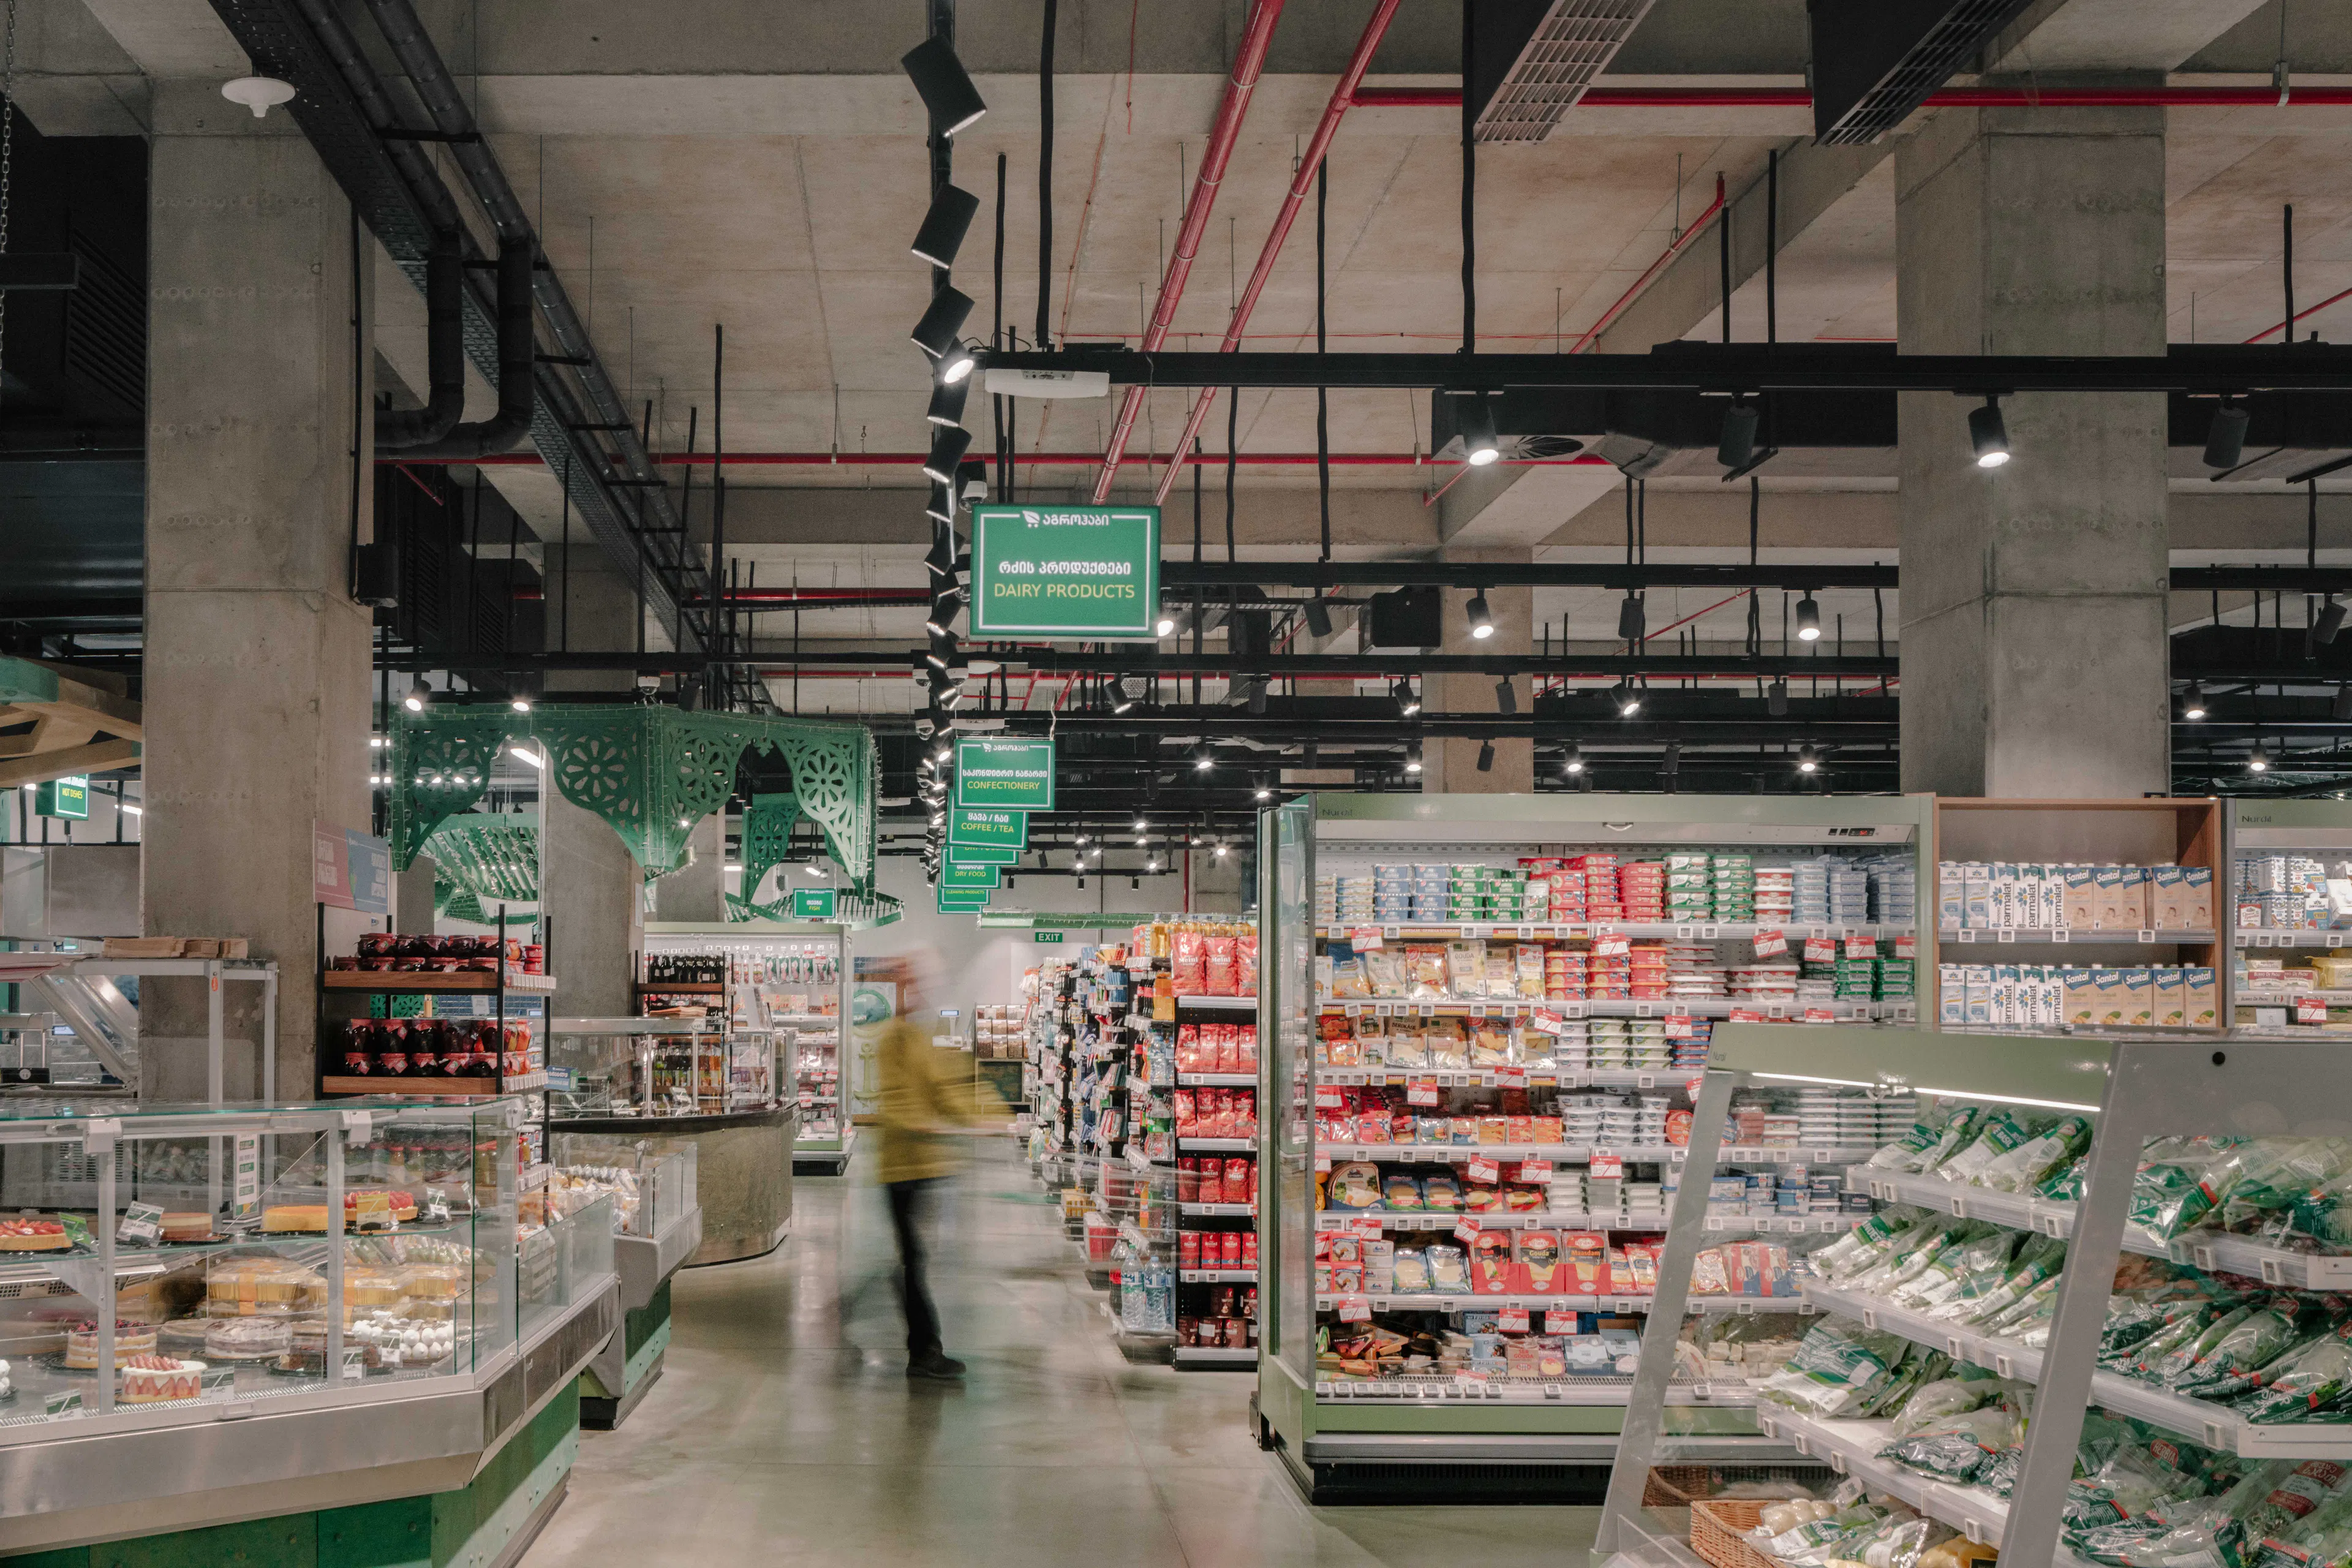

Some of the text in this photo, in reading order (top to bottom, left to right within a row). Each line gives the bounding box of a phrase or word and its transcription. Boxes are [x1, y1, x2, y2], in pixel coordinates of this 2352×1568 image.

[1042, 514, 1109, 526] აგროჰაბი
[998, 561, 1131, 575] რძის პროდუქტები
[994, 583, 1135, 598] DAIRY PRODUCTS
[962, 769, 1047, 778] საკონდიტრო ნაწარმი
[967, 781, 1040, 790] CONFECTIONERY
[968, 813, 987, 821] ყავა
[995, 813, 1009, 823] ჩაი
[961, 823, 992, 831] COFFEE
[2066, 869, 2089, 883] Santal
[2097, 869, 2120, 883] Santal
[2122, 869, 2140, 882] antal
[2157, 869, 2180, 883] Santal
[2186, 870, 2208, 881] Santal
[2003, 883, 2011, 927] parmalat
[1038, 933, 1060, 941] EXIT
[2065, 971, 2089, 984] Santal
[2095, 971, 2119, 984] Santal
[2126, 971, 2149, 984] Santal
[2157, 971, 2180, 984] Santal
[2188, 970, 2211, 984] Santal
[2052, 986, 2061, 1023] armalat
[1903, 1133, 1928, 1146] RAGON
[1997, 1132, 2014, 1148] BASIL
[2154, 1441, 2176, 1464] HERBIA
